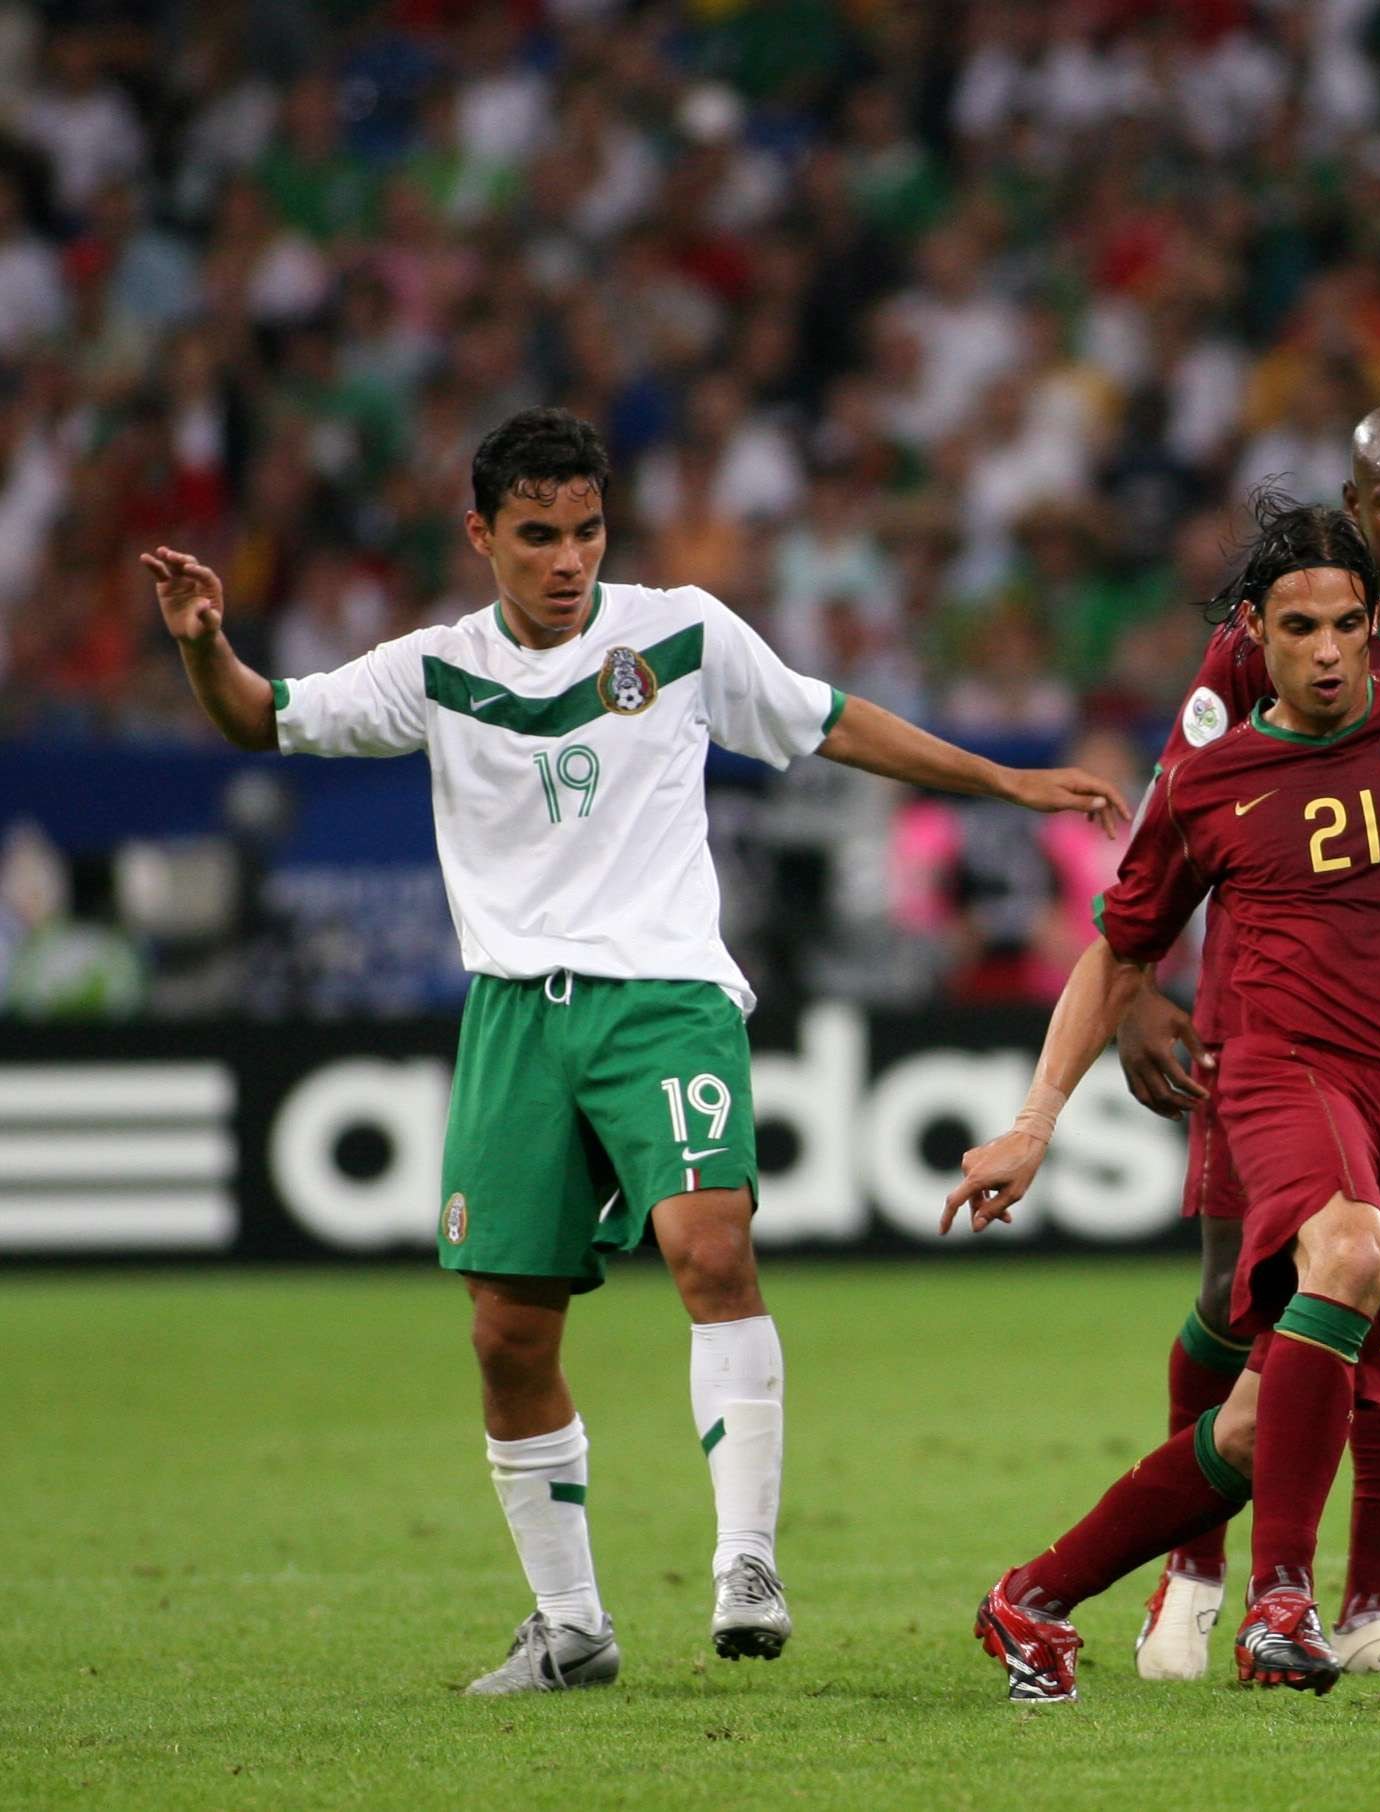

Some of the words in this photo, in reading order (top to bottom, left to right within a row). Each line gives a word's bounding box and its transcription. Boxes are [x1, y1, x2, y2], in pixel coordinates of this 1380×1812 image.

[533, 744, 600, 824] 19
[270, 1002, 1190, 1248] adas
[661, 1073, 732, 1142] 19
